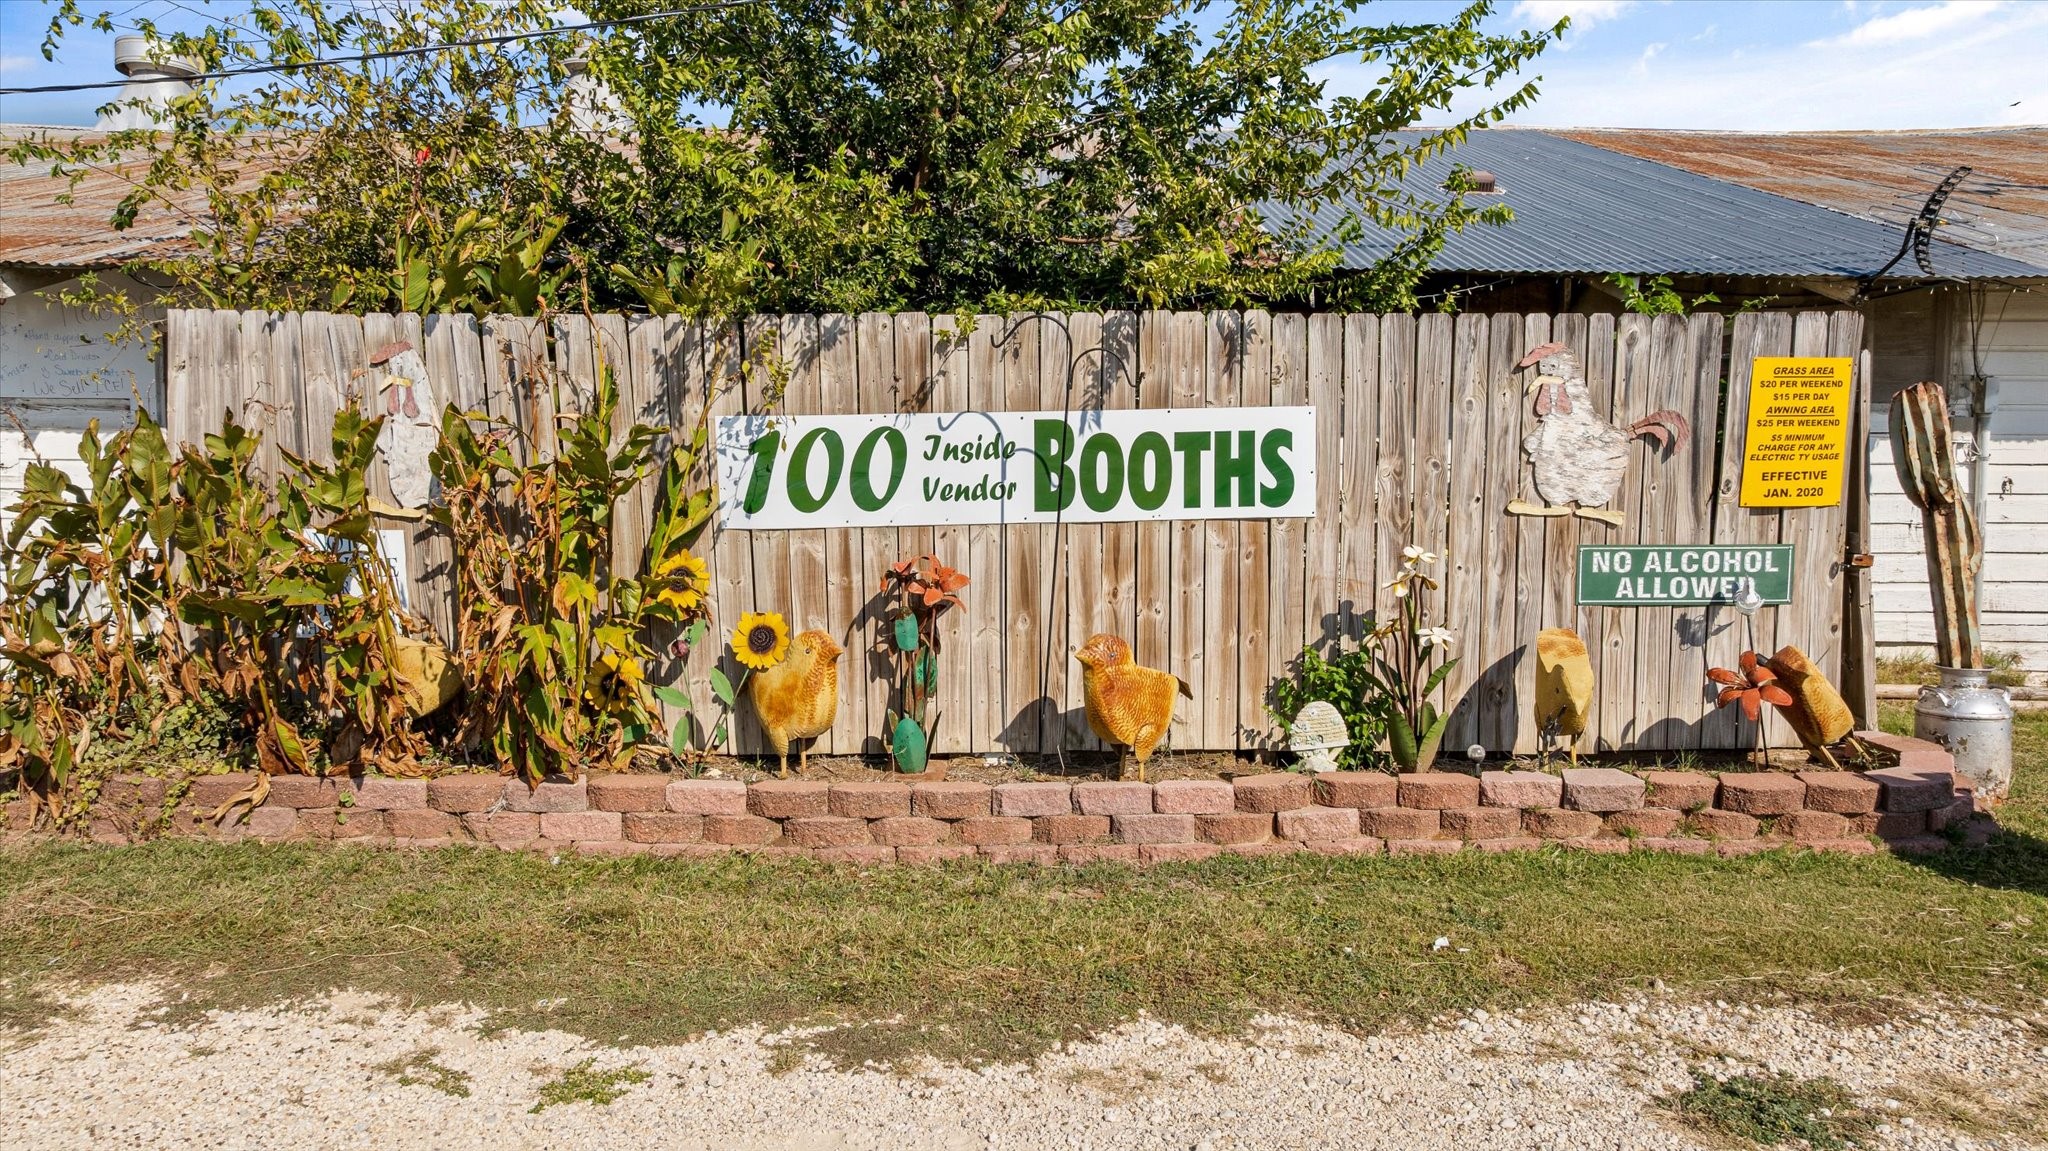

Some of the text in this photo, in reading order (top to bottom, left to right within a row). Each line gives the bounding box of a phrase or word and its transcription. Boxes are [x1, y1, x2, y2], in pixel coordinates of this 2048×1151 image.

[1774, 367, 1834, 375] GRASS AREA
[33, 381, 56, 396] We
[1760, 380, 1843, 388] $20 PER WEEKEND
[1773, 393, 1830, 401] $15 PER DAY
[1766, 406, 1835, 414] AWNING AREA
[1756, 419, 1840, 427] $25 PER WEEKEND
[922, 432, 1016, 463] Inside
[1817, 443, 1835, 451] ANY
[743, 426, 907, 514] 100
[1033, 418, 1295, 513] BOOTHS
[1761, 470, 1828, 481] EFFECTIVE
[923, 475, 1017, 502] Vendor
[1763, 487, 1824, 498] JAN. 2020
[1592, 550, 1779, 573] NO ALCOHOL
